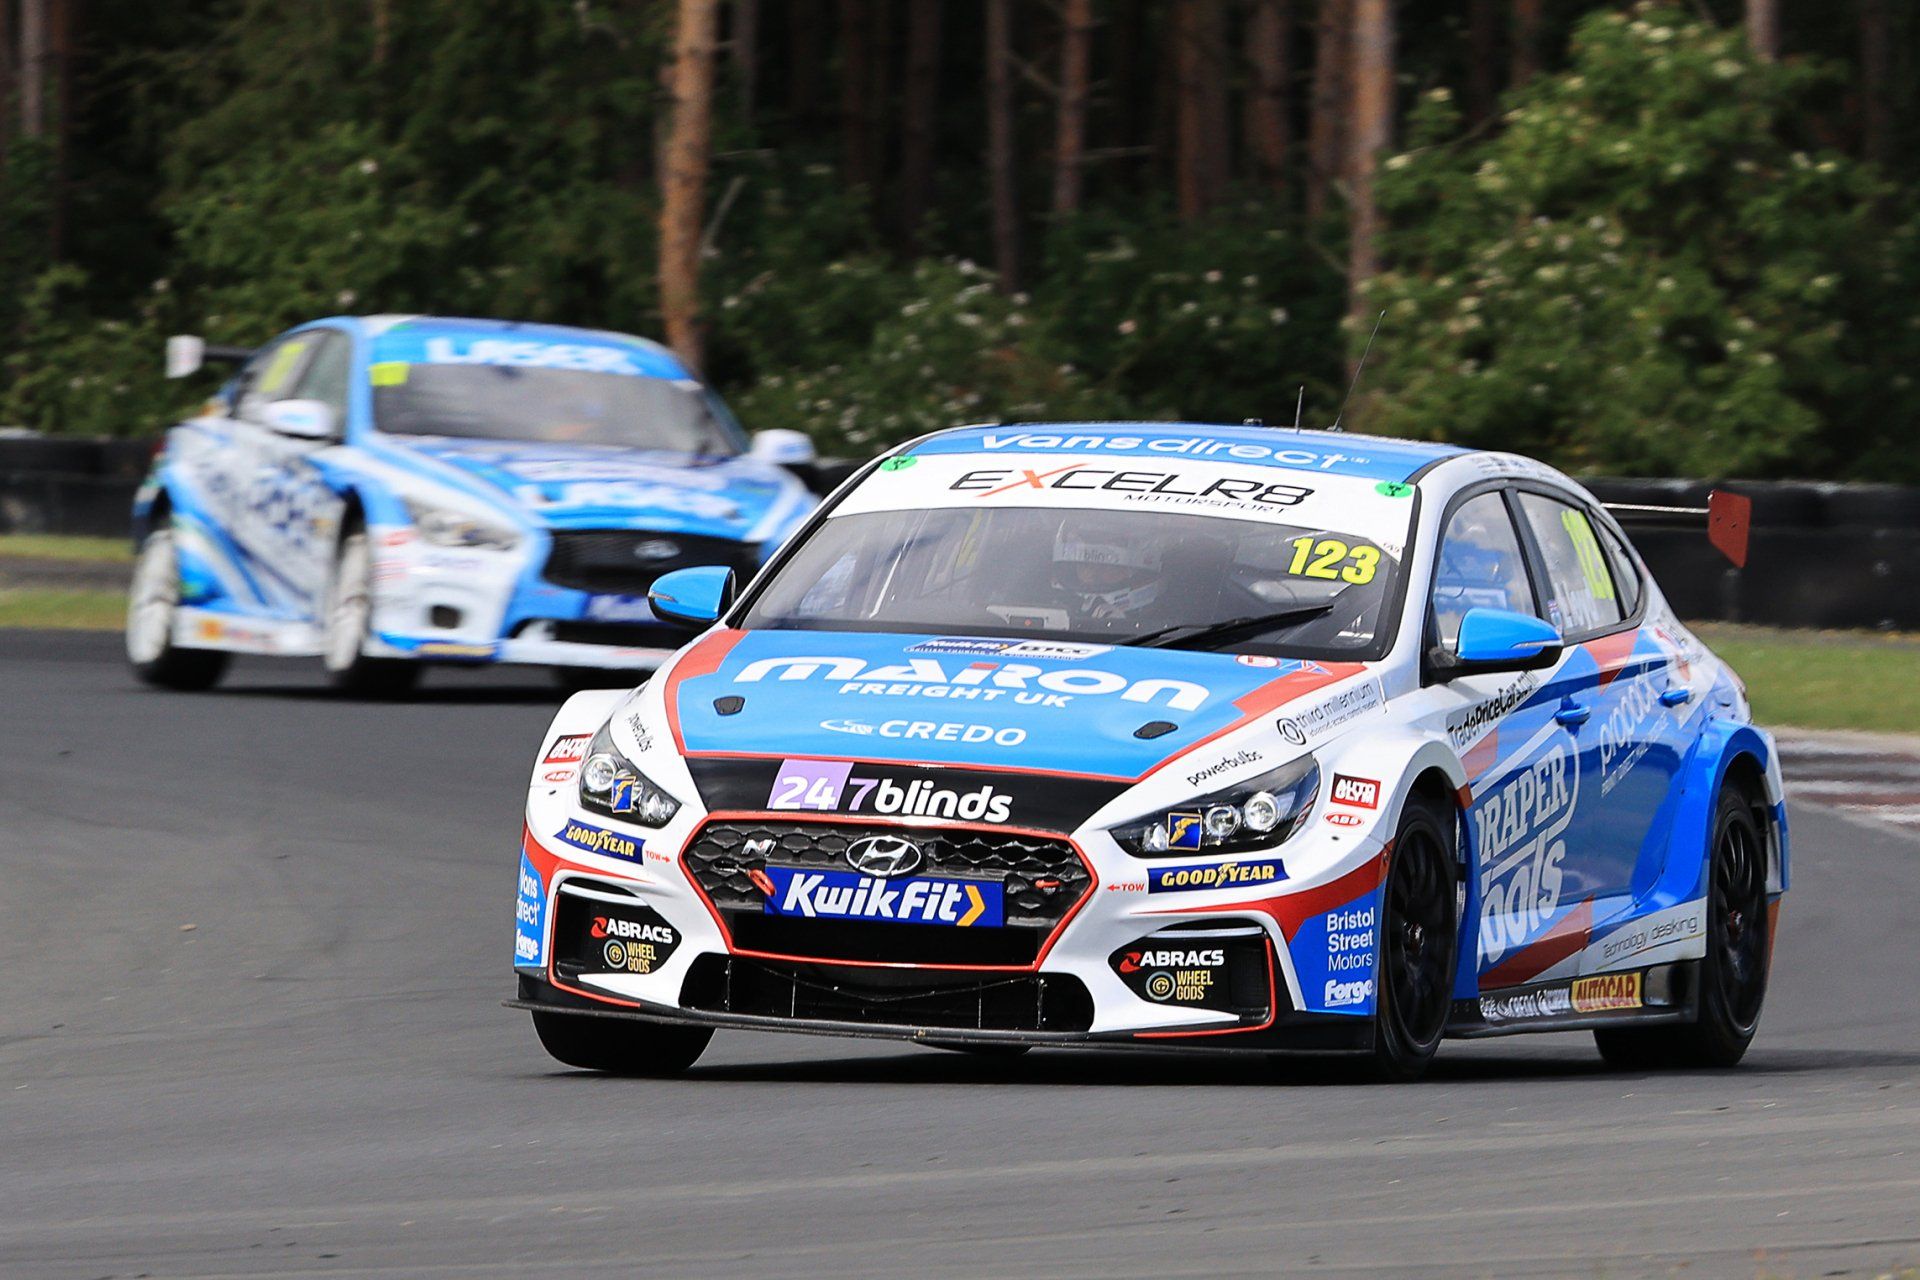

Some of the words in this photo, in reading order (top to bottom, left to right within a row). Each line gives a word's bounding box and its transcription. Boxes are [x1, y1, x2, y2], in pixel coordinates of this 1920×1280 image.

[1124, 494, 1289, 514] MOTORSPORT
[1288, 537, 1380, 585] 123
[838, 681, 1006, 702] FREIGHT
[1013, 691, 1076, 708] UK
[878, 719, 1028, 747] CREDO
[646, 850, 662, 861] TOW
[1121, 883, 1145, 892] TOW
[1327, 907, 1374, 932] Bristol
[606, 918, 673, 944] ABRACS
[1328, 929, 1374, 953] Street
[626, 941, 657, 961] WHEEL
[1140, 950, 1225, 967] ABRACS
[627, 959, 651, 974] GODS
[1328, 952, 1373, 972] Motors
[1176, 970, 1213, 986] WHEEL
[1176, 985, 1205, 1000] GODS
[1576, 975, 1637, 1009] AUTOCAR
